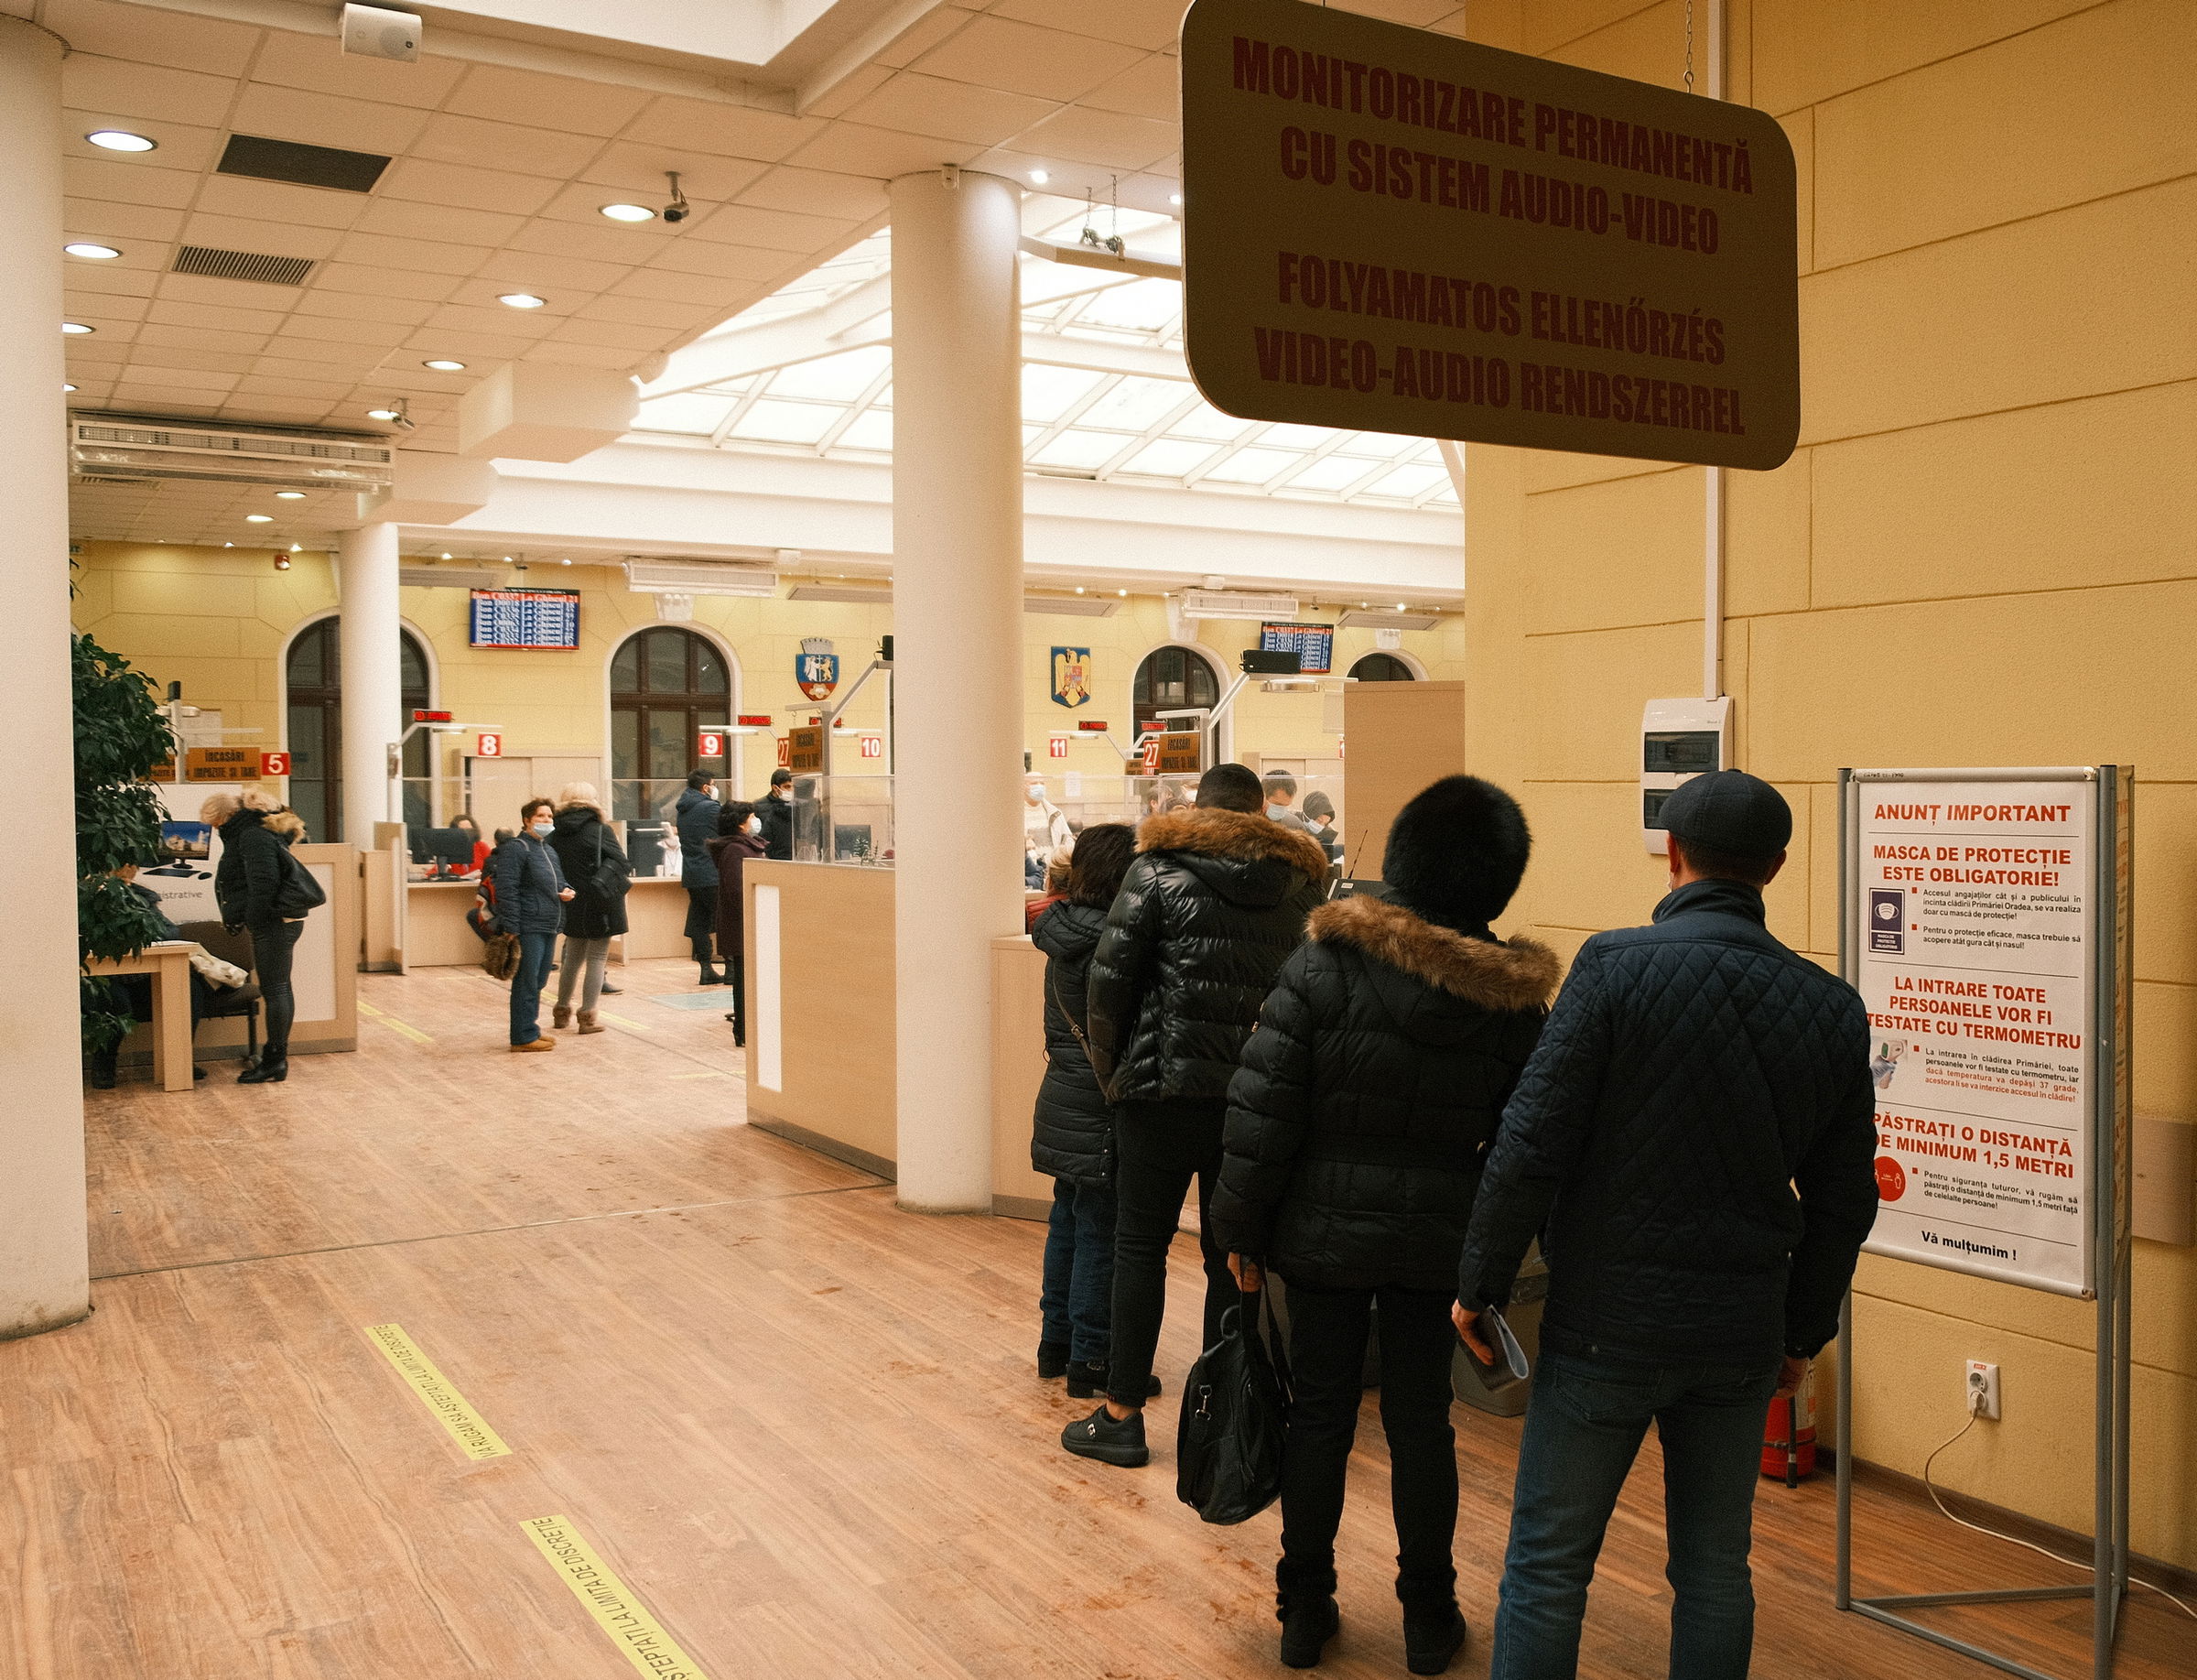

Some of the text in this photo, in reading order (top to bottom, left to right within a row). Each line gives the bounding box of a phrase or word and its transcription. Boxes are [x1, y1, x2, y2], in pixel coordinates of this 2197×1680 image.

[1232, 36, 1753, 194] MONITORIZARE PERMANENTĂ
[1282, 126, 1719, 255] CU SISTEM AUDIO-VIDEO
[1278, 251, 1725, 365] FOLYAMATOS ELLENŐRZÉS
[1253, 327, 1747, 435] VIDEO-AUDIO RENDSZERREL
[482, 735, 497, 755] 8
[705, 735, 719, 754] 9
[779, 740, 789, 765] 27
[862, 739, 880, 756] 10
[1052, 740, 1066, 757] 11
[1145, 743, 1159, 766] 27
[268, 754, 284, 774] 5
[1875, 805, 2071, 826] ANUNȚ IMPORTANT
[1874, 845, 2071, 869] MASCA DE PROTECȚIE
[1883, 866, 2059, 886] ESTE OBLIGATORIE!
[1923, 889, 1951, 897] Accesul
[1954, 891, 1992, 900] angajaților
[2030, 894, 2070, 903] publicului
[2073, 894, 2081, 903] în
[1923, 898, 1946, 906] incinta
[1947, 899, 1971, 907] clădirii
[1972, 900, 2003, 909] Primăriei
[2005, 902, 2033, 912] Oradea,
[1949, 909, 1972, 917] mască
[1983, 912, 2018, 921] protecție!
[1923, 926, 1946, 934] Pentru
[1954, 928, 1986, 938] protecție
[1986, 929, 2015, 939] eficace,
[2042, 933, 2071, 942] trebuie
[1966, 939, 1982, 948] gura
[1983, 938, 1995, 947] cât
[1996, 940, 2002, 948] și
[2003, 941, 2025, 949] nasul!
[1895, 976, 2046, 1003] LA INTRARE TOATE
[1889, 995, 2052, 1025] PERSOANELE VOR FI
[1867, 1013, 2081, 1050] TESTATE CU TERMOMETRU
[1925, 1047, 1934, 1056] La
[1938, 1049, 1967, 1059] intrarea
[1982, 1055, 2012, 1065] clădirea
[2016, 1058, 2054, 1071] Primăriei,
[2058, 1065, 2079, 1073] toate
[1925, 1058, 1964, 1068] persoanele
[1978, 1063, 1984, 1071] fi
[1985, 1065, 2009, 1074] testate
[2021, 1069, 2067, 1082] termometru,
[2069, 1075, 2080, 1083] iar
[1925, 1067, 1943, 1076] dacă
[1947, 1069, 1993, 1081] temperatura
[2009, 1078, 2036, 1089] depăși
[2053, 1084, 2079, 1094] grade,
[1925, 1077, 1955, 1087] acestora
[1979, 1083, 2009, 1094] interzice
[2010, 1088, 2039, 1098] accesul
[2039, 1090, 2047, 1099] în
[2048, 1092, 2075, 1102] clădire!
[1872, 1111, 2073, 1159] PĂSTRAȚI O DISTANȚĂ
[1897, 1136, 1977, 1163] MINIMUM
[1983, 1151, 2009, 1169] 1,5
[2015, 1155, 2073, 1178] METRI
[1924, 1170, 2078, 1204] Pentru siguranța tuturor, vă rugăm să
[1924, 1181, 1950, 1192] păstrați
[1956, 1187, 1985, 1198] distanță
[1986, 1191, 1995, 1199] de
[1996, 1193, 2030, 1206] minimum
[2031, 1198, 2042, 1208] 1,5
[2043, 1202, 2062, 1211] metri
[2062, 1204, 2078, 1215] față
[1933, 1192, 1962, 1203] celelalte
[1963, 1198, 1998, 1209] persoane!
[1921, 1230, 2017, 1261] Vă mulțumim !
[450, 1422, 490, 1447] RUGĂM
[531, 1517, 694, 1680] ȘTEPTAȚI LA LIMITA DE DISCREȚIE
